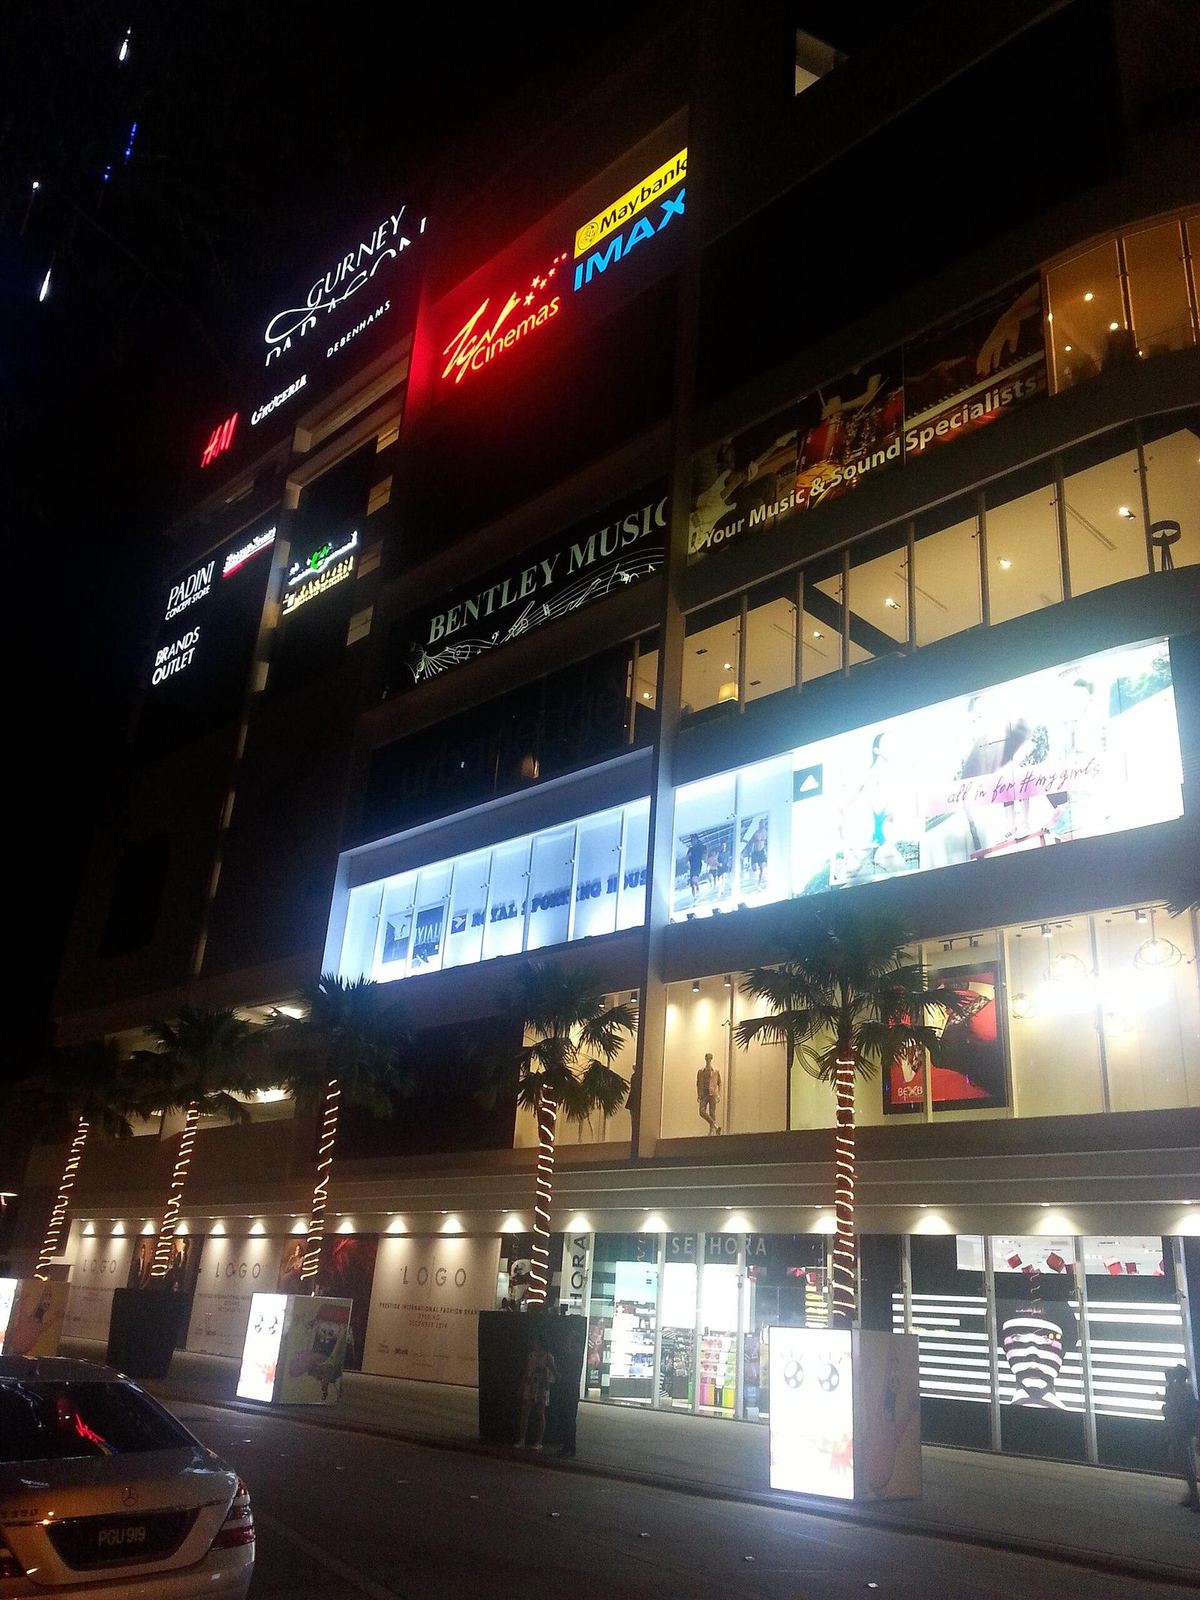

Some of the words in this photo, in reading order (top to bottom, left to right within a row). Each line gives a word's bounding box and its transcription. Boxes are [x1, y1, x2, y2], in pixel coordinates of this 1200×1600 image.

[291, 204, 407, 322] GURNEY
[573, 188, 686, 292] IMAX
[326, 299, 391, 358] DEBENHAMS
[703, 516, 745, 549] Your
[748, 488, 806, 528] Music
[809, 475, 826, 497] &
[830, 438, 902, 491] Sound
[905, 374, 1039, 452] Specialists
[166, 560, 216, 610] PADINI
[190, 584, 212, 608] STORE
[427, 552, 561, 646] BENTLEY
[151, 647, 195, 686] OUTLET
[154, 626, 200, 667] BRANDS
[947, 781, 970, 804] all
[974, 783, 987, 799] in
[991, 776, 1016, 804] for
[1019, 756, 1101, 793] #mygirls
[671, 1236, 767, 1256] SEHORA
